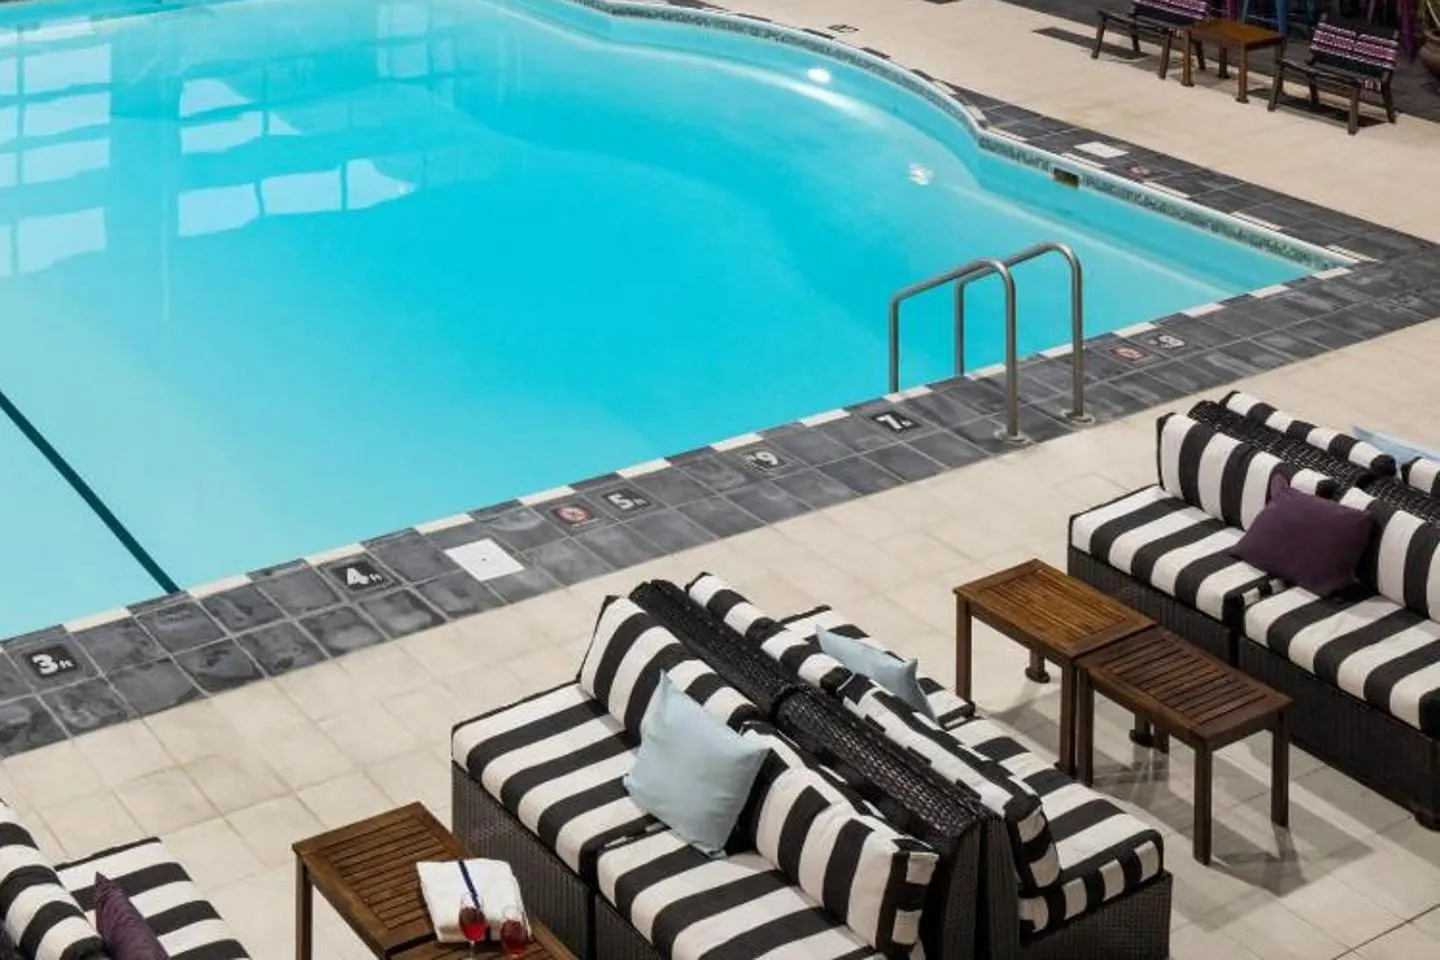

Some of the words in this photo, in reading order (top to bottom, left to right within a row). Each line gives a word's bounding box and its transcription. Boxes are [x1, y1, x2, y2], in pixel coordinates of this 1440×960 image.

[876, 414, 902, 430] 7
[755, 451, 778, 466] 6
[608, 492, 634, 510] 5
[347, 568, 369, 586] 4
[32, 654, 58, 675] 3
